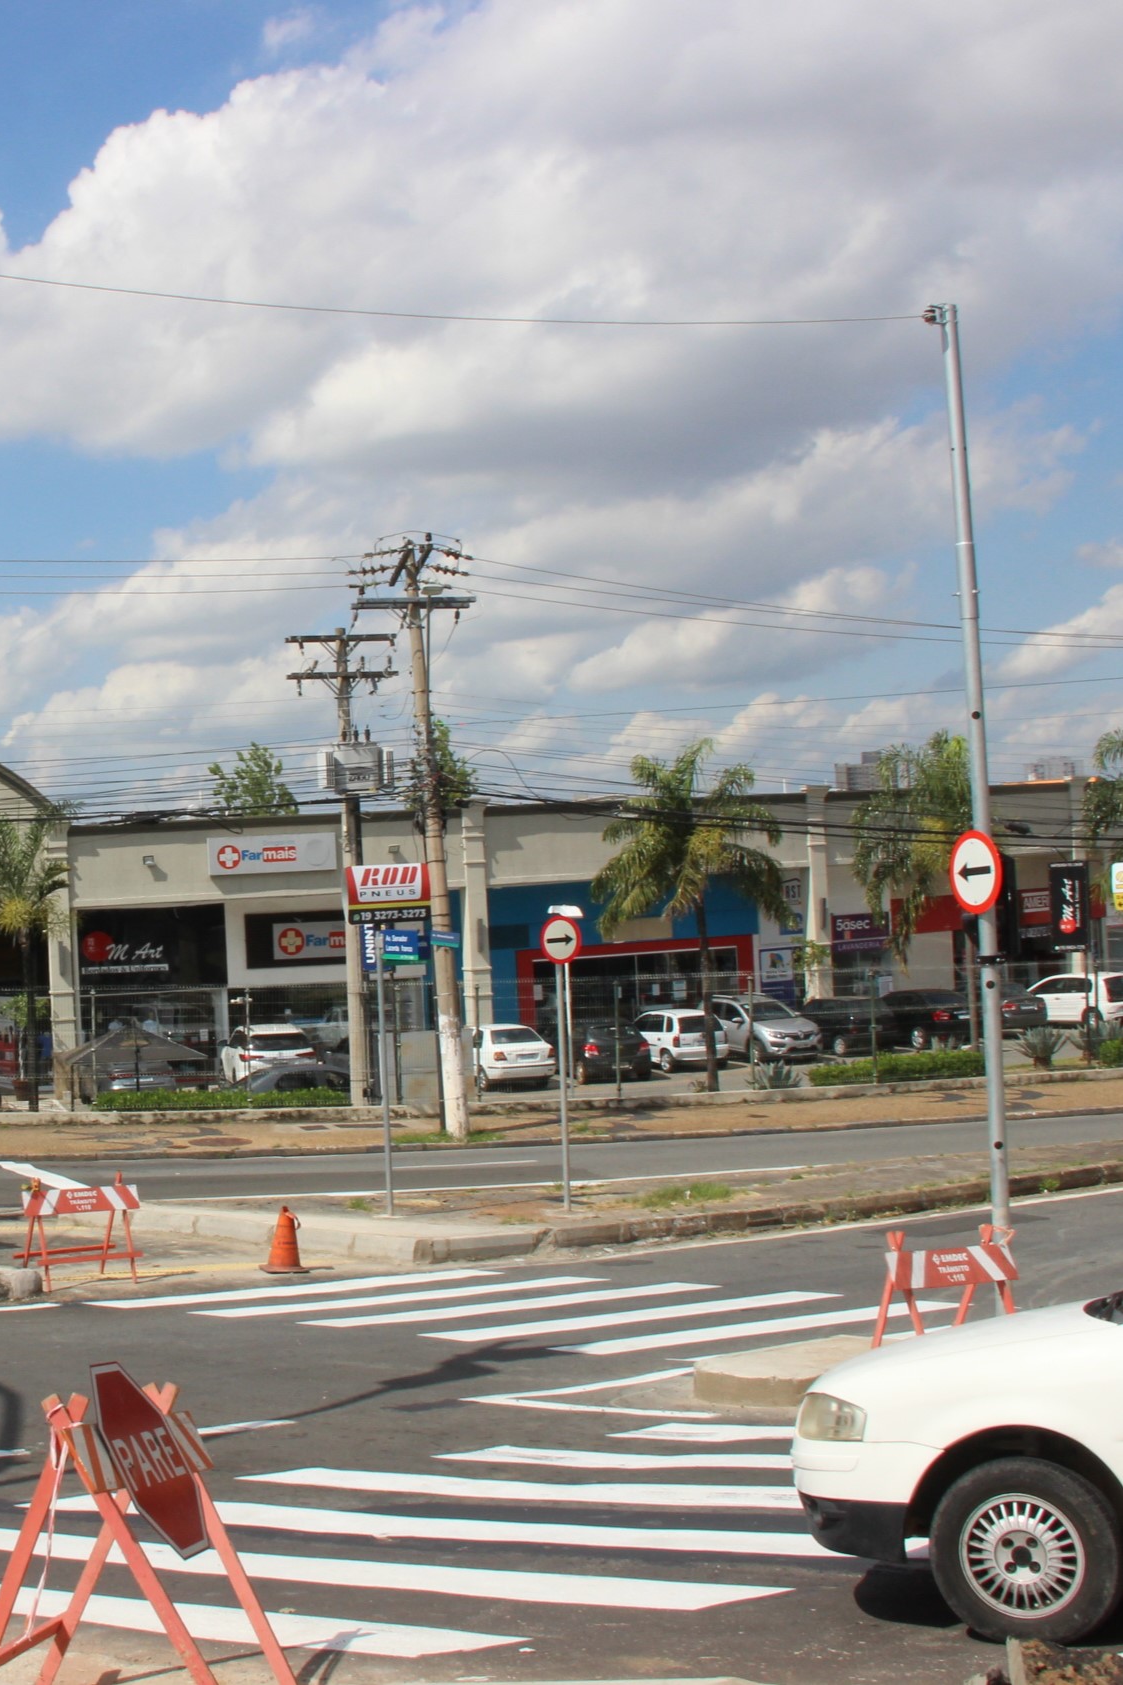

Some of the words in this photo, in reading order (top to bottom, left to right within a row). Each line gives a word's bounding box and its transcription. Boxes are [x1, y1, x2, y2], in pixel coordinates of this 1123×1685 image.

[241, 847, 297, 861] Farmais
[359, 889, 417, 898] PNEUS
[360, 911, 372, 921] 19
[374, 909, 426, 920] 3273-3273
[132, 942, 164, 960] Art
[838, 943, 881, 952] LAVANDERIA
[940, 1252, 969, 1262] EMDEC
[111, 1426, 187, 1492] PARE
